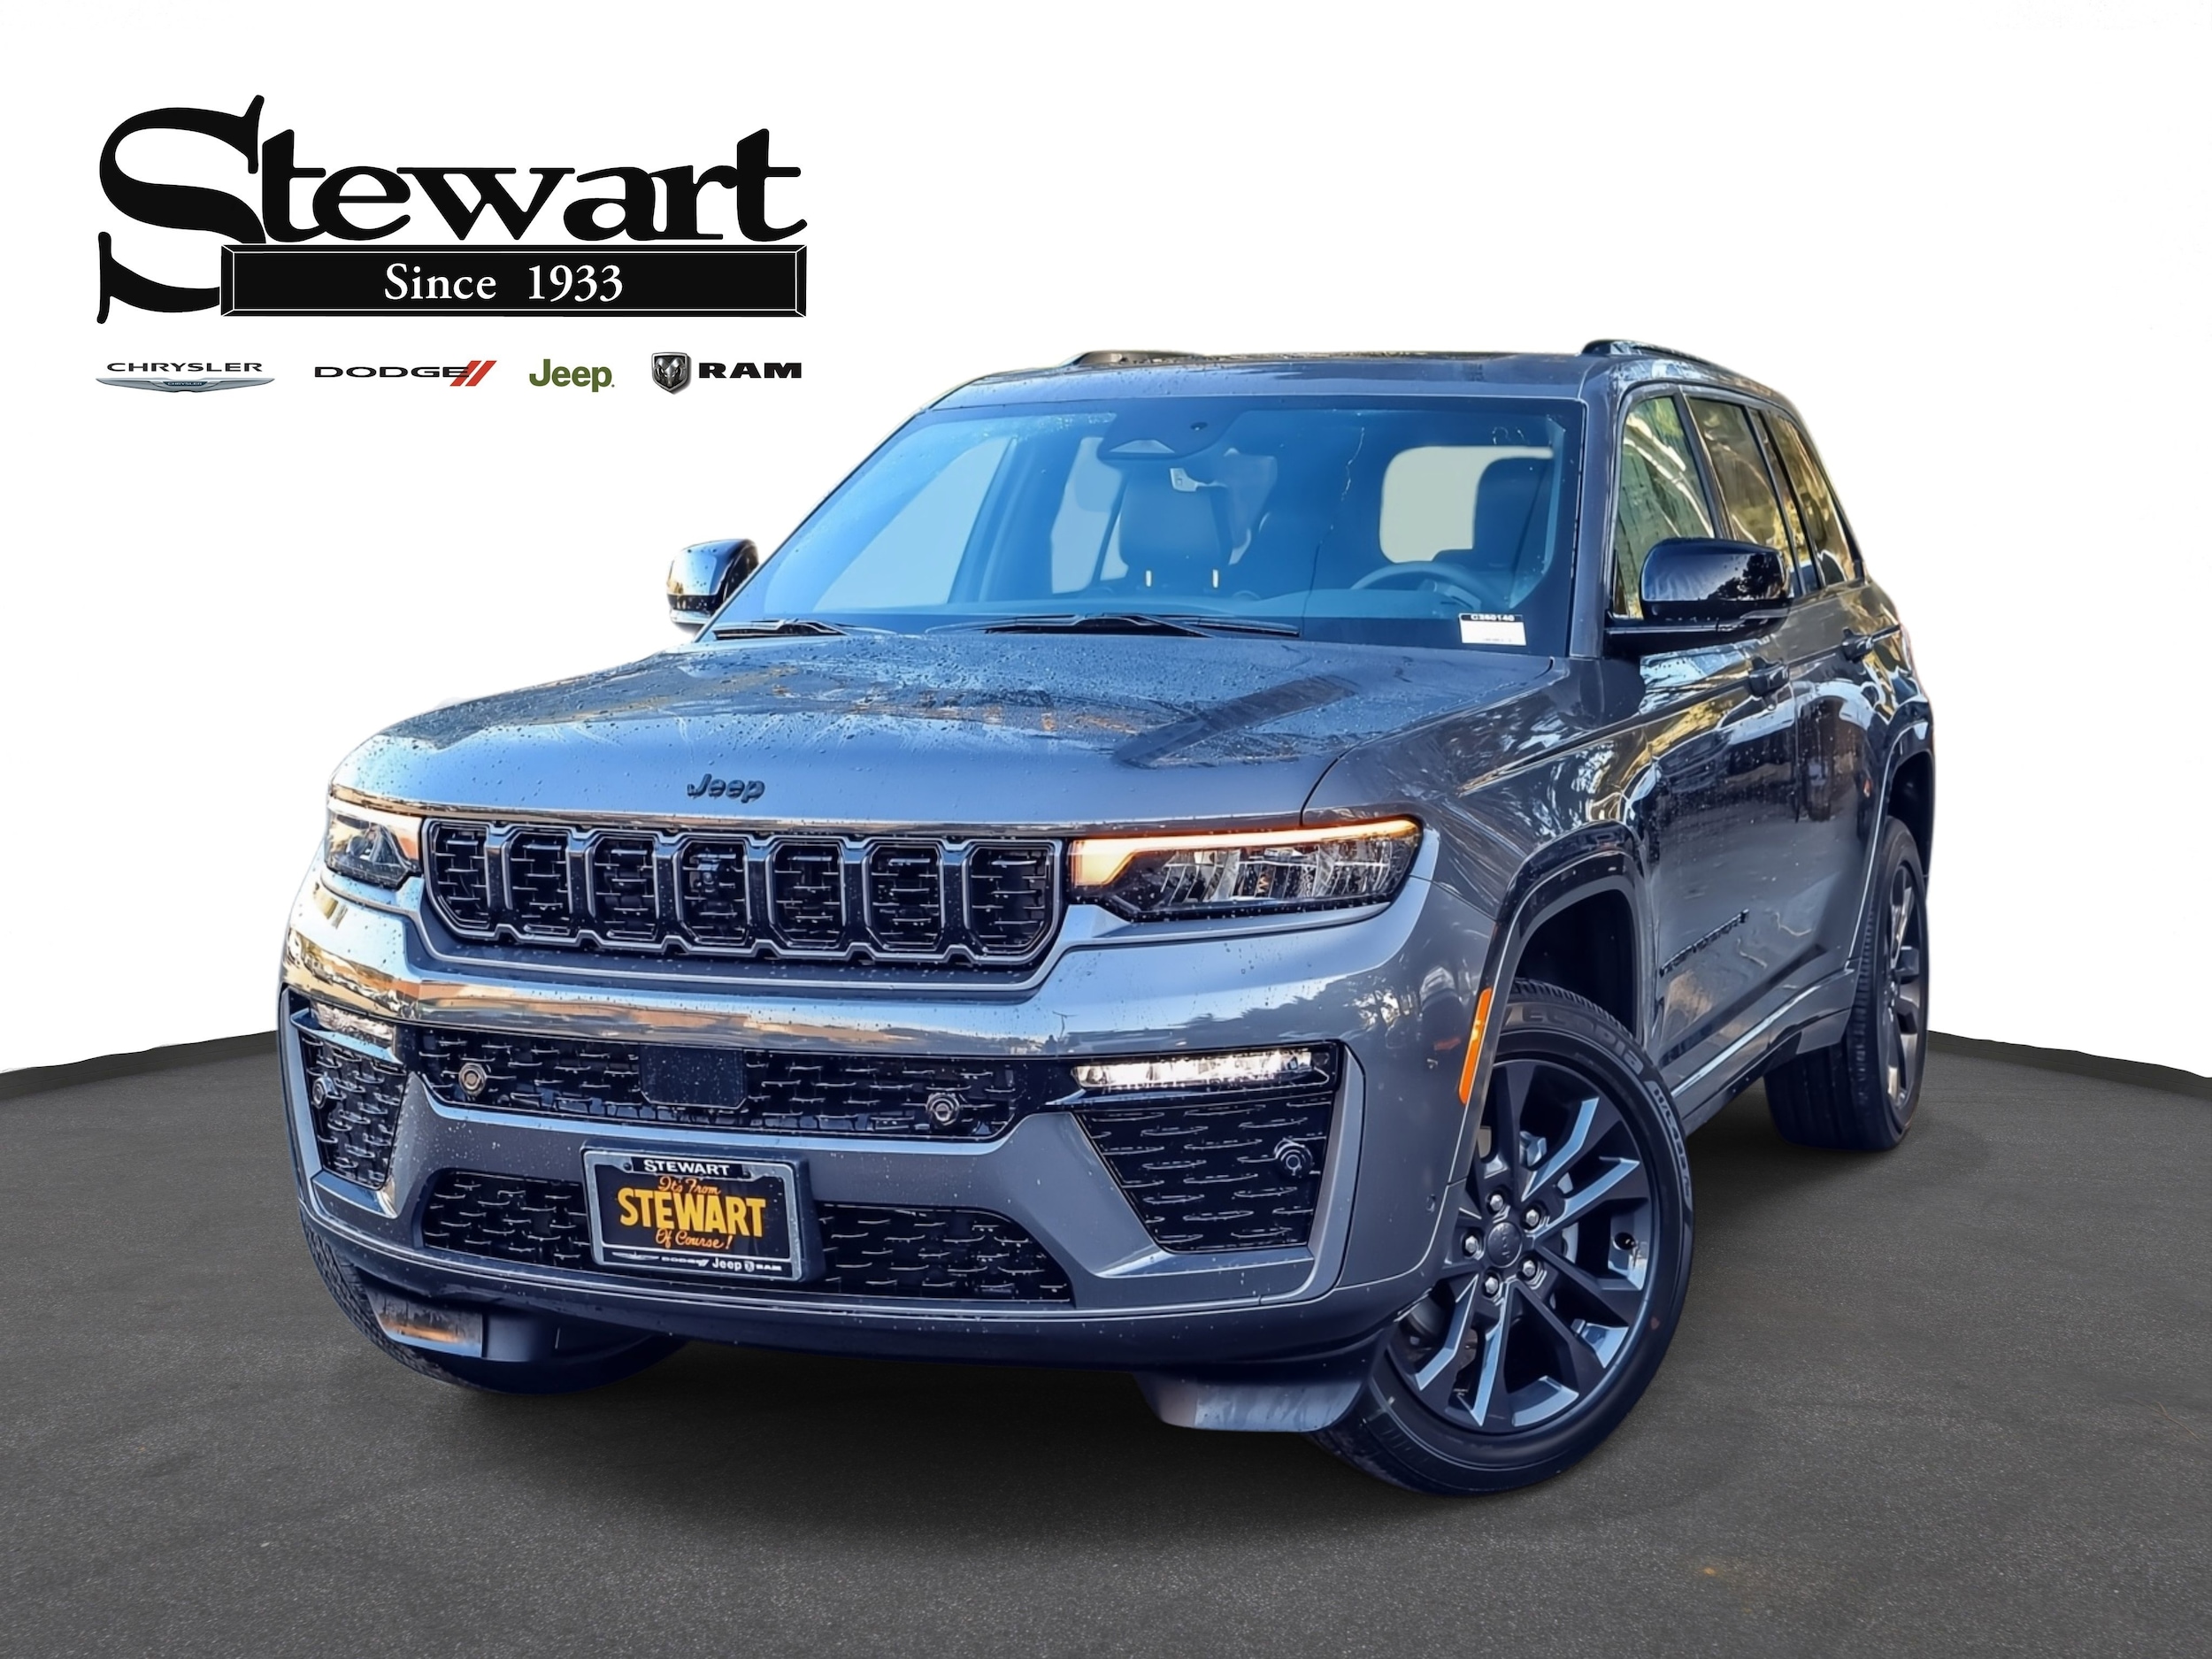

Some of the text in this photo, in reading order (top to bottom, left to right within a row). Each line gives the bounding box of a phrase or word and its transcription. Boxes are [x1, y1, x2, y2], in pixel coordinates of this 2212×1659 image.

[687, 773, 766, 803] Jeep
[643, 1158, 731, 1177] STEWART
[685, 1178, 722, 1196] From
[618, 1187, 766, 1237] STEWART
[656, 1227, 672, 1249] Of
[711, 1257, 742, 1271] Jeep
